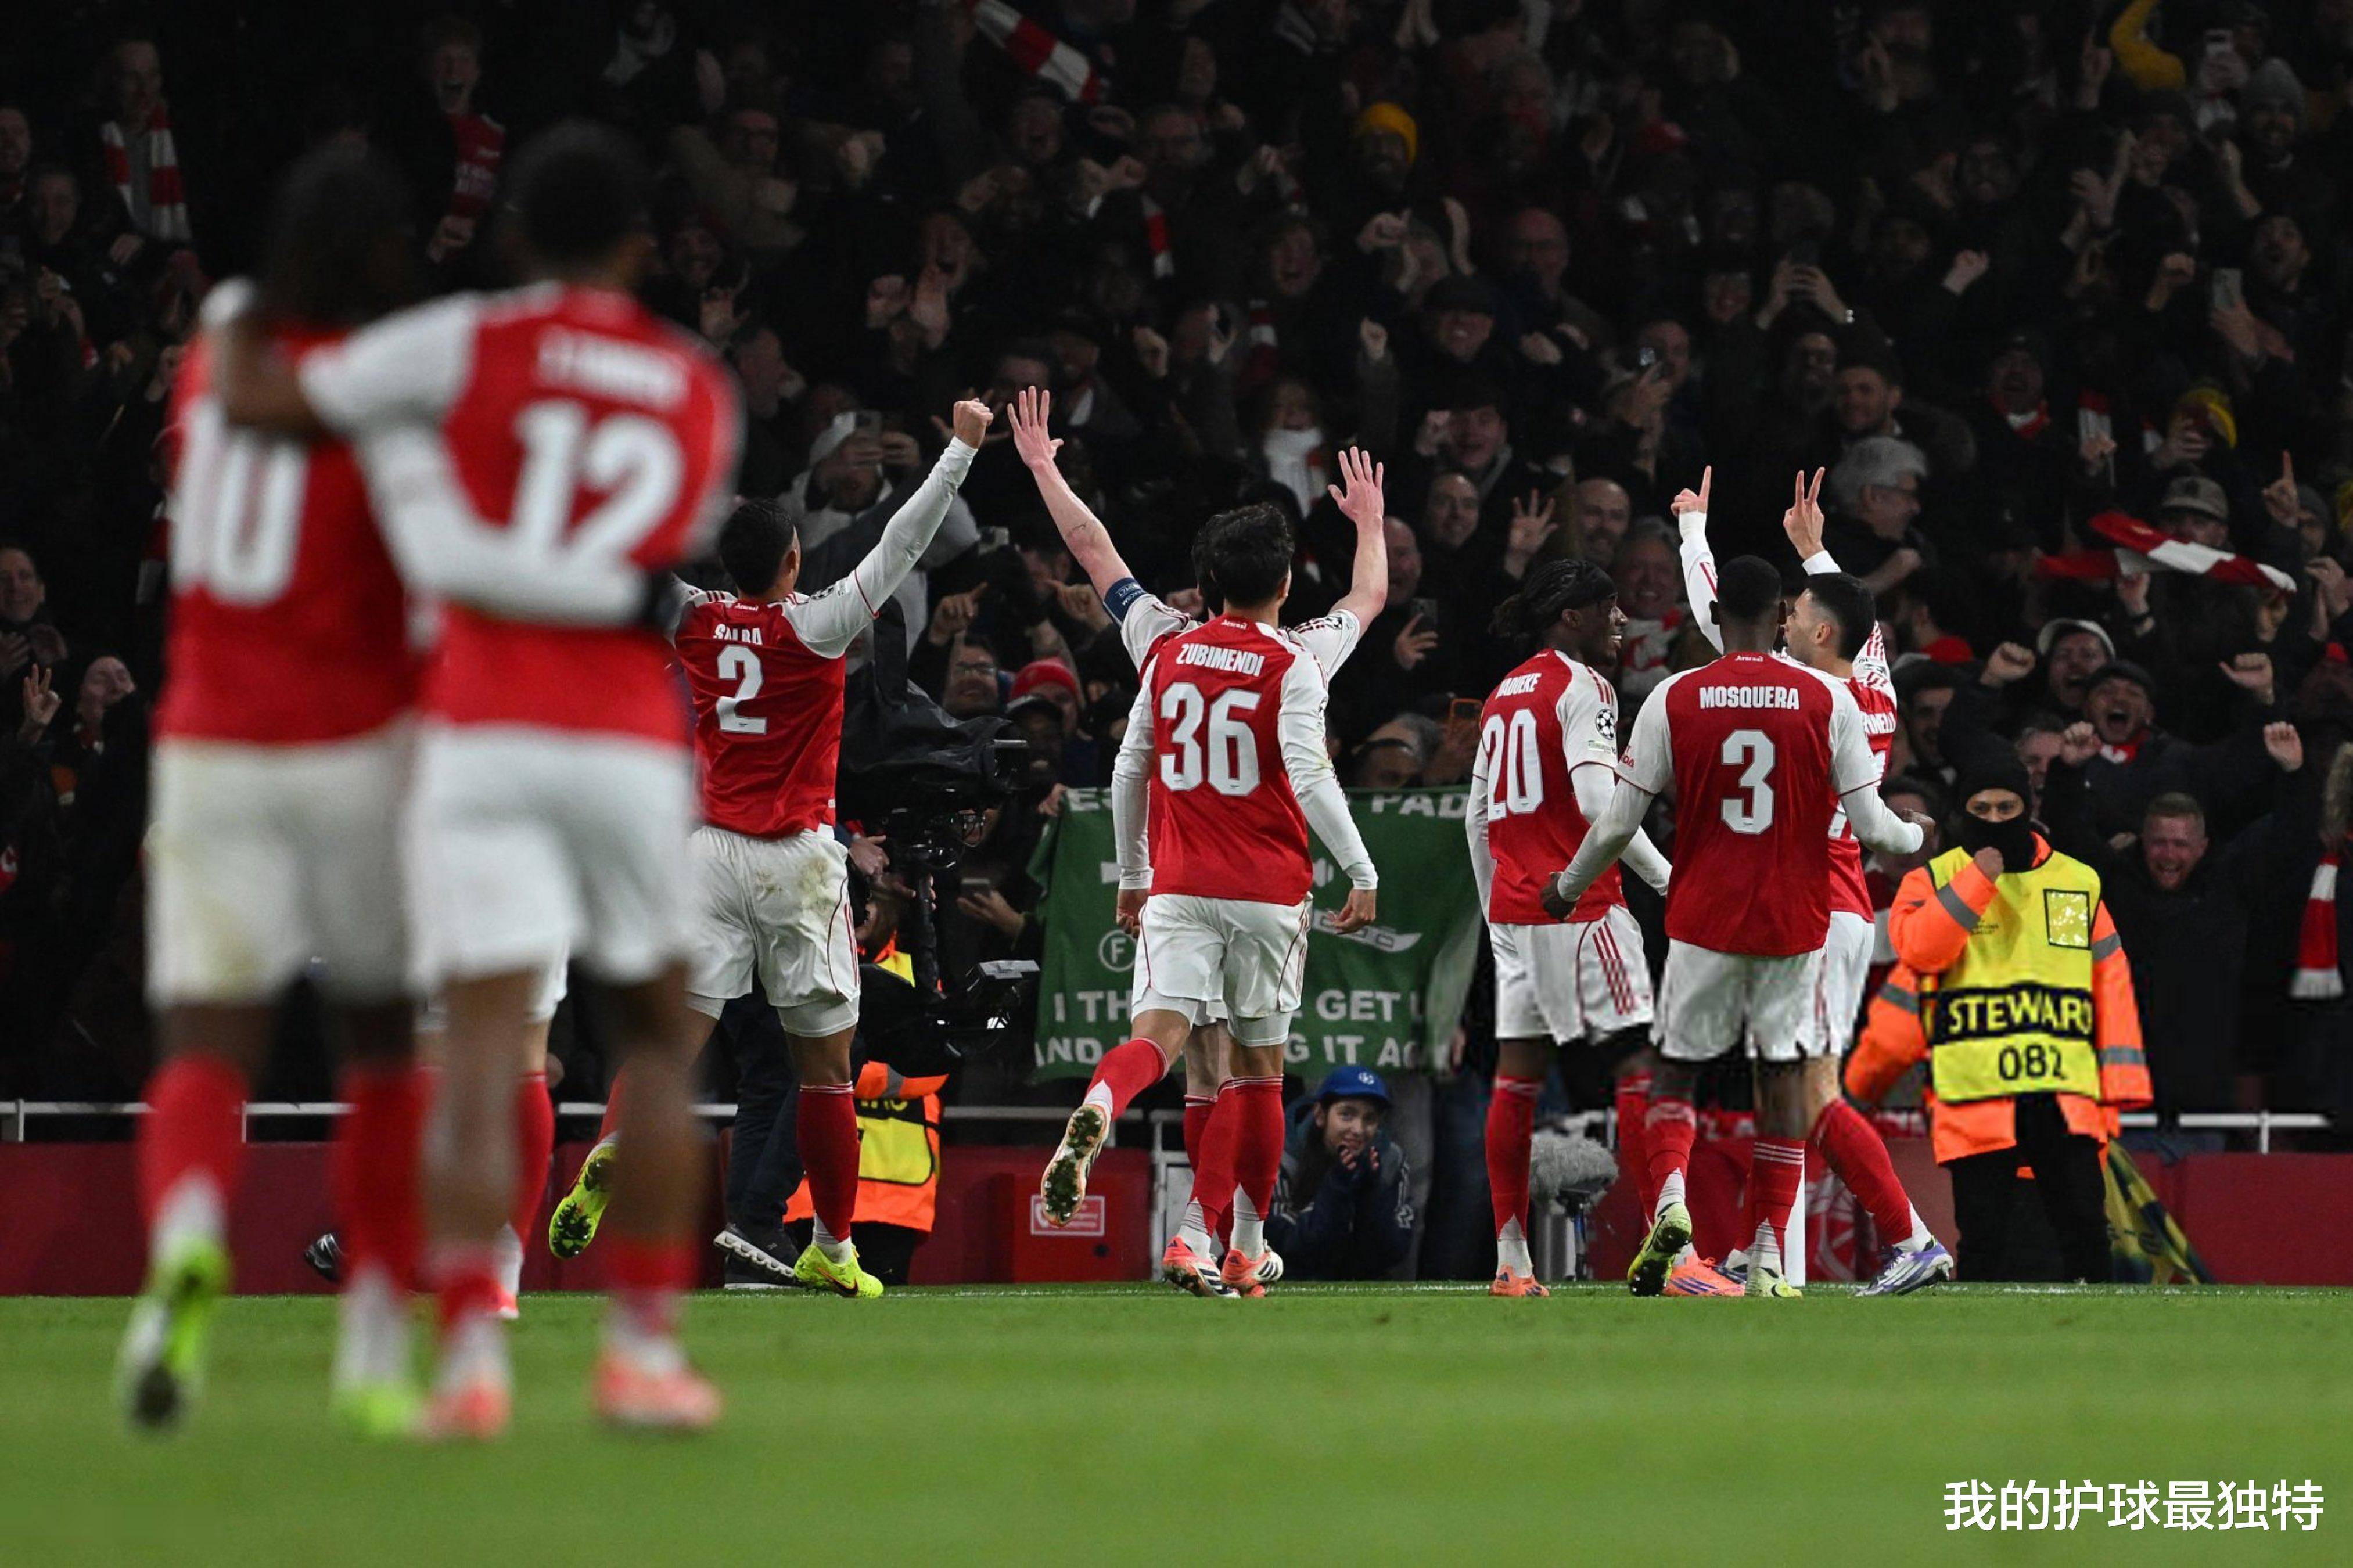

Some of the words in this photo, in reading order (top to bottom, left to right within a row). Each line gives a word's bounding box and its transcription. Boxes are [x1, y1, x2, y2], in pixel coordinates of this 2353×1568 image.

[513, 398, 685, 566] 12
[715, 644, 768, 735] 2
[1176, 643, 1266, 677] ZUBIMENDI
[1699, 685, 1800, 710] MOSQUERA
[1159, 681, 1262, 797] 36
[1482, 707, 1545, 823] 20
[1720, 729, 1776, 835] 3
[1109, 937, 1126, 964] F
[1054, 992, 1066, 1023] I
[1316, 988, 1401, 1022] GET
[1323, 1035, 1365, 1066] IT
